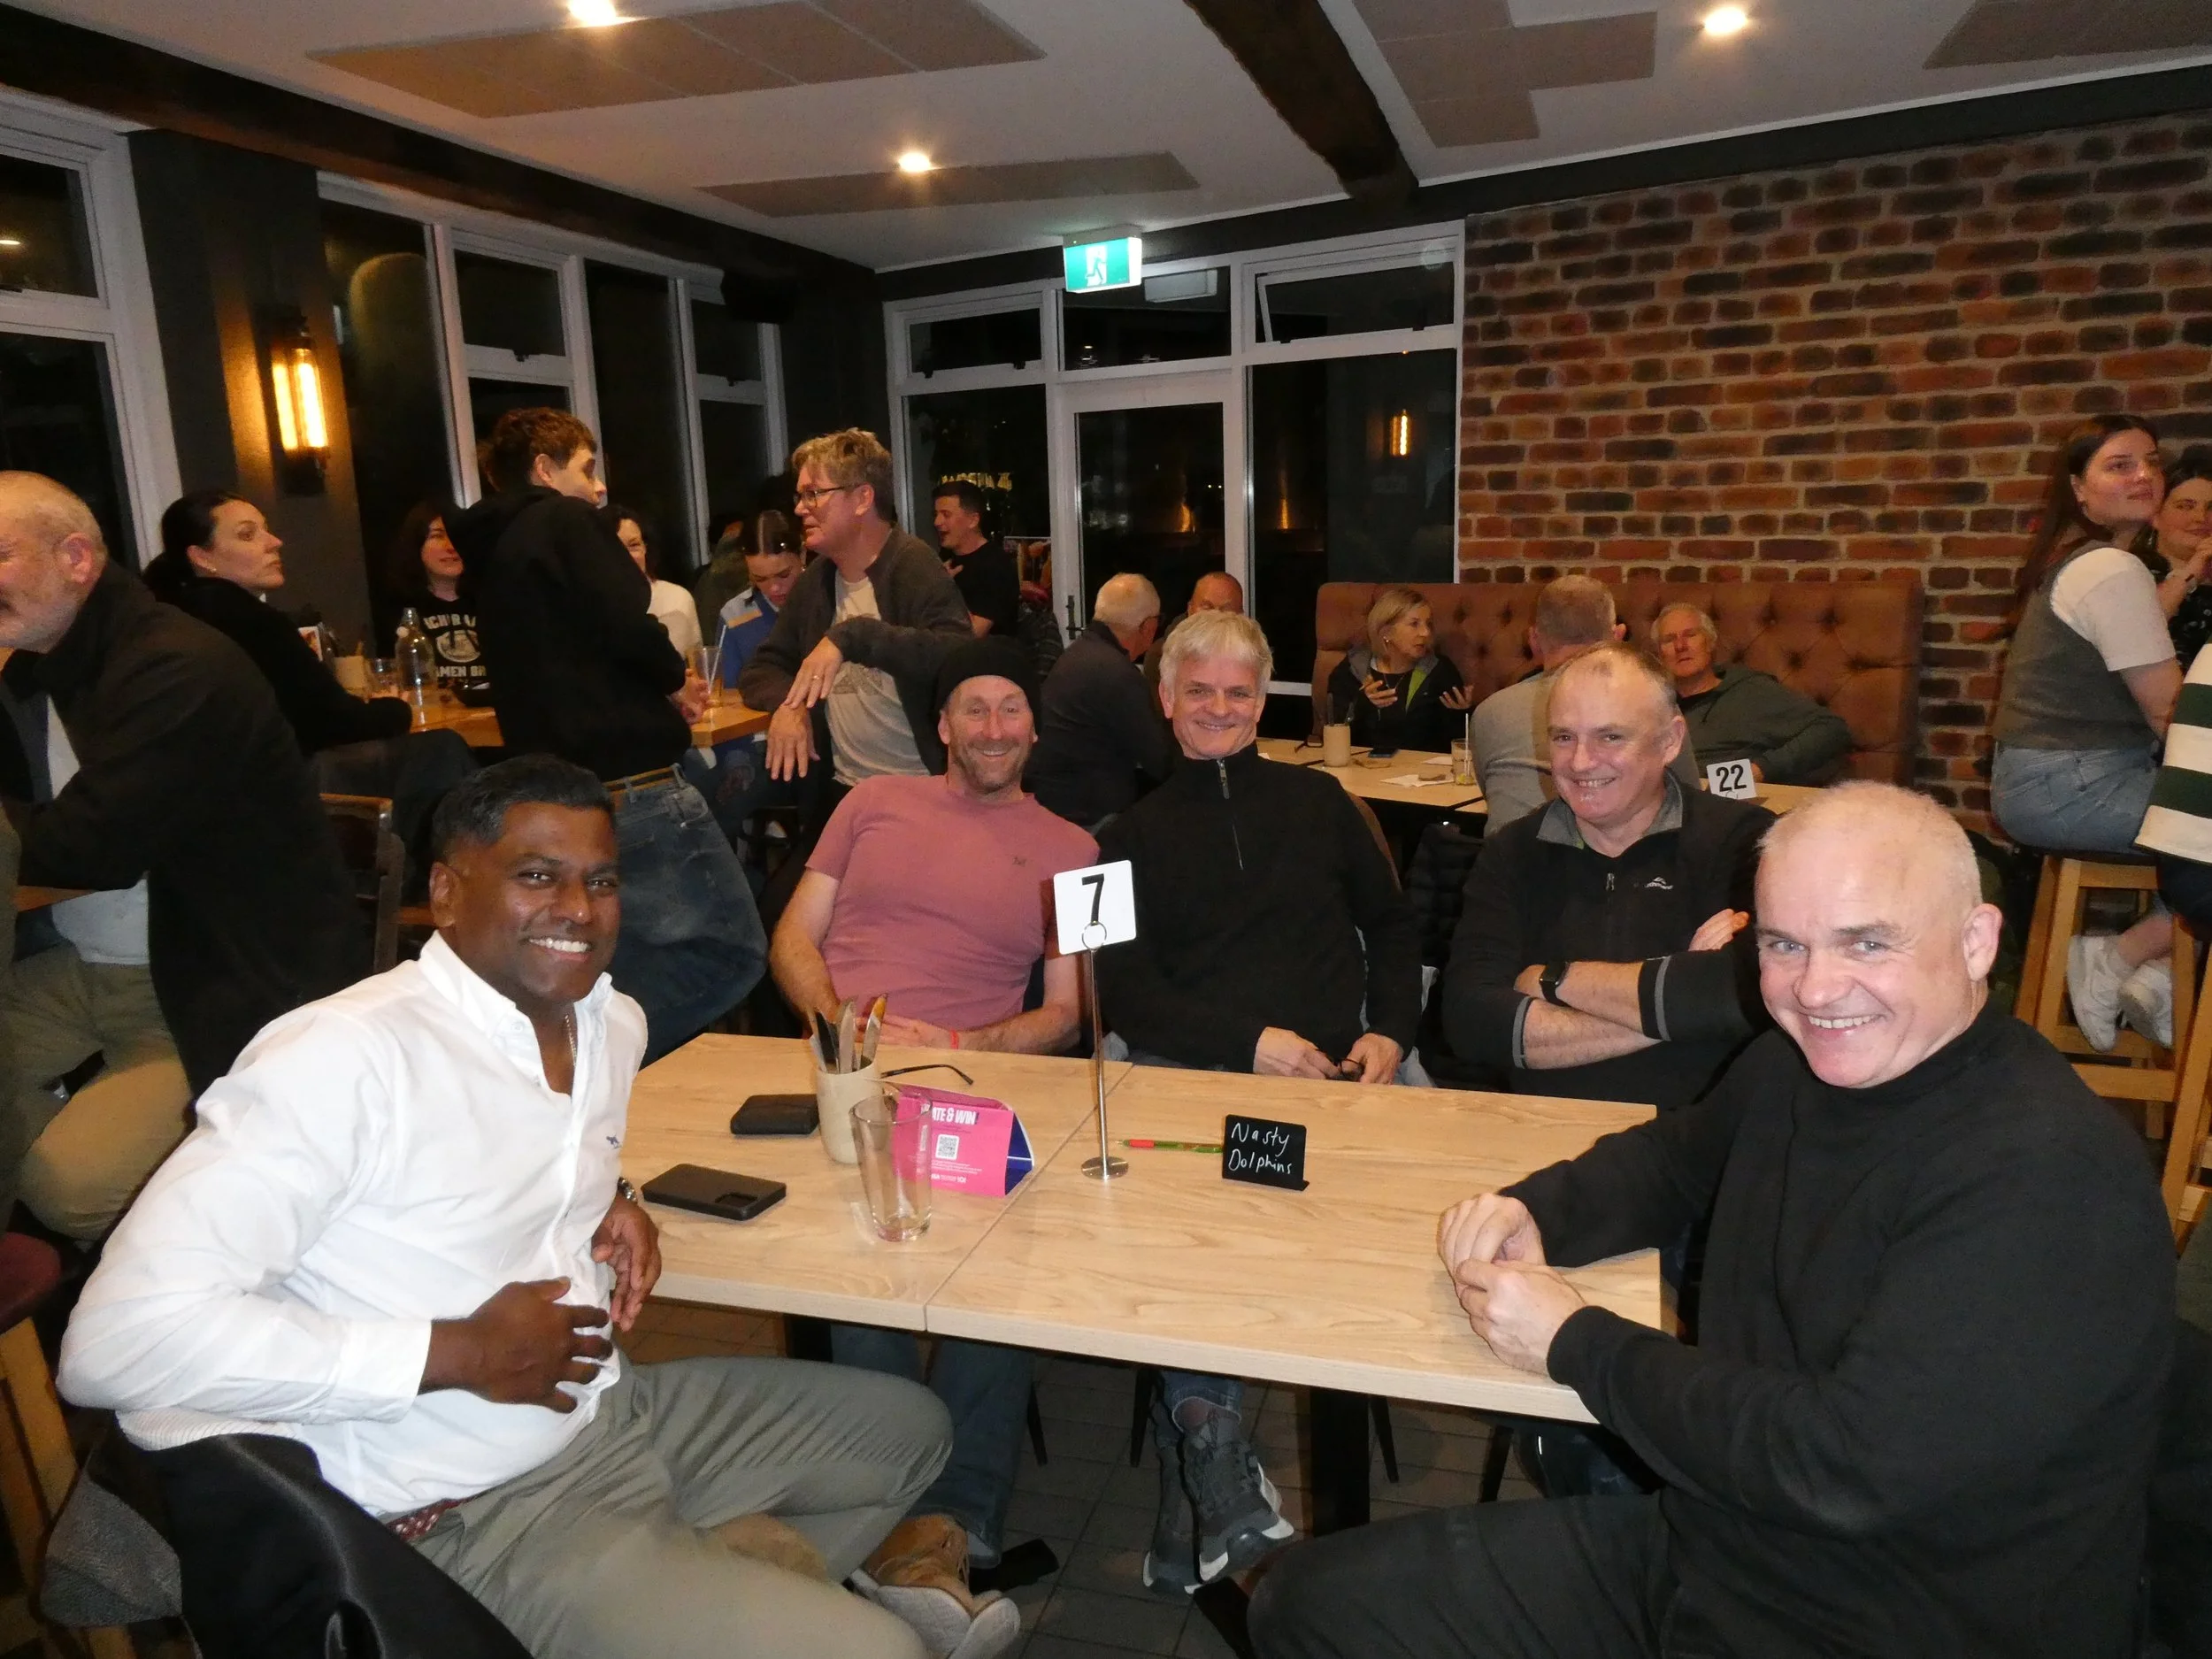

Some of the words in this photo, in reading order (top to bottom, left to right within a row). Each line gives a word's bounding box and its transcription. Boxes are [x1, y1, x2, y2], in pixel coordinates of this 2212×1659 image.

[1716, 764, 1747, 792] 22
[1081, 873, 1104, 926] 7
[946, 1108, 954, 1122] &
[955, 1110, 977, 1125] WIN
[1231, 1122, 1290, 1156] Nasty
[1228, 1148, 1293, 1175] Dolphins
